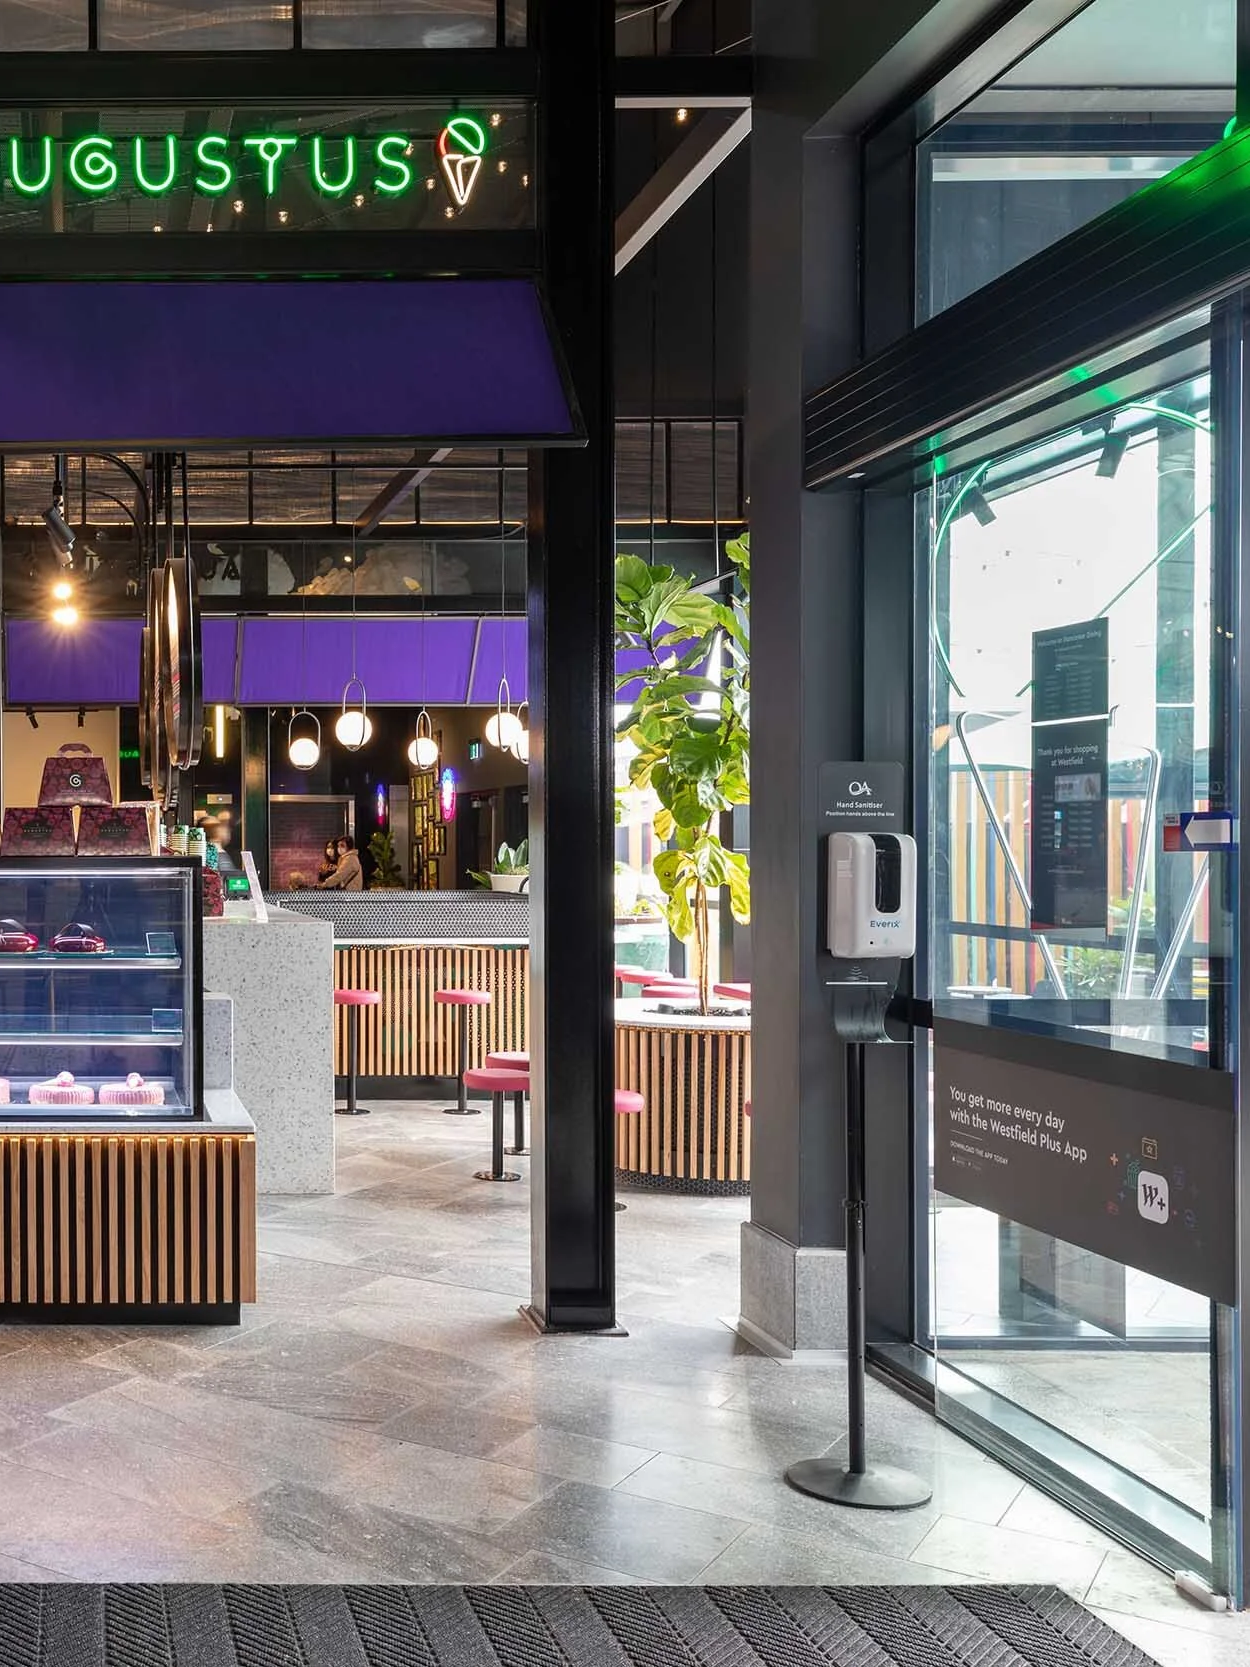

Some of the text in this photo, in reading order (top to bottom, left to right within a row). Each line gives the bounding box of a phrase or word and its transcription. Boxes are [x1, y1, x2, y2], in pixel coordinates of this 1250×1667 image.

[836, 801, 884, 809] Hand Sanitiser
[949, 1085, 1065, 1133] You get more every day
[949, 1107, 1088, 1164] with the Westfield Plus App
